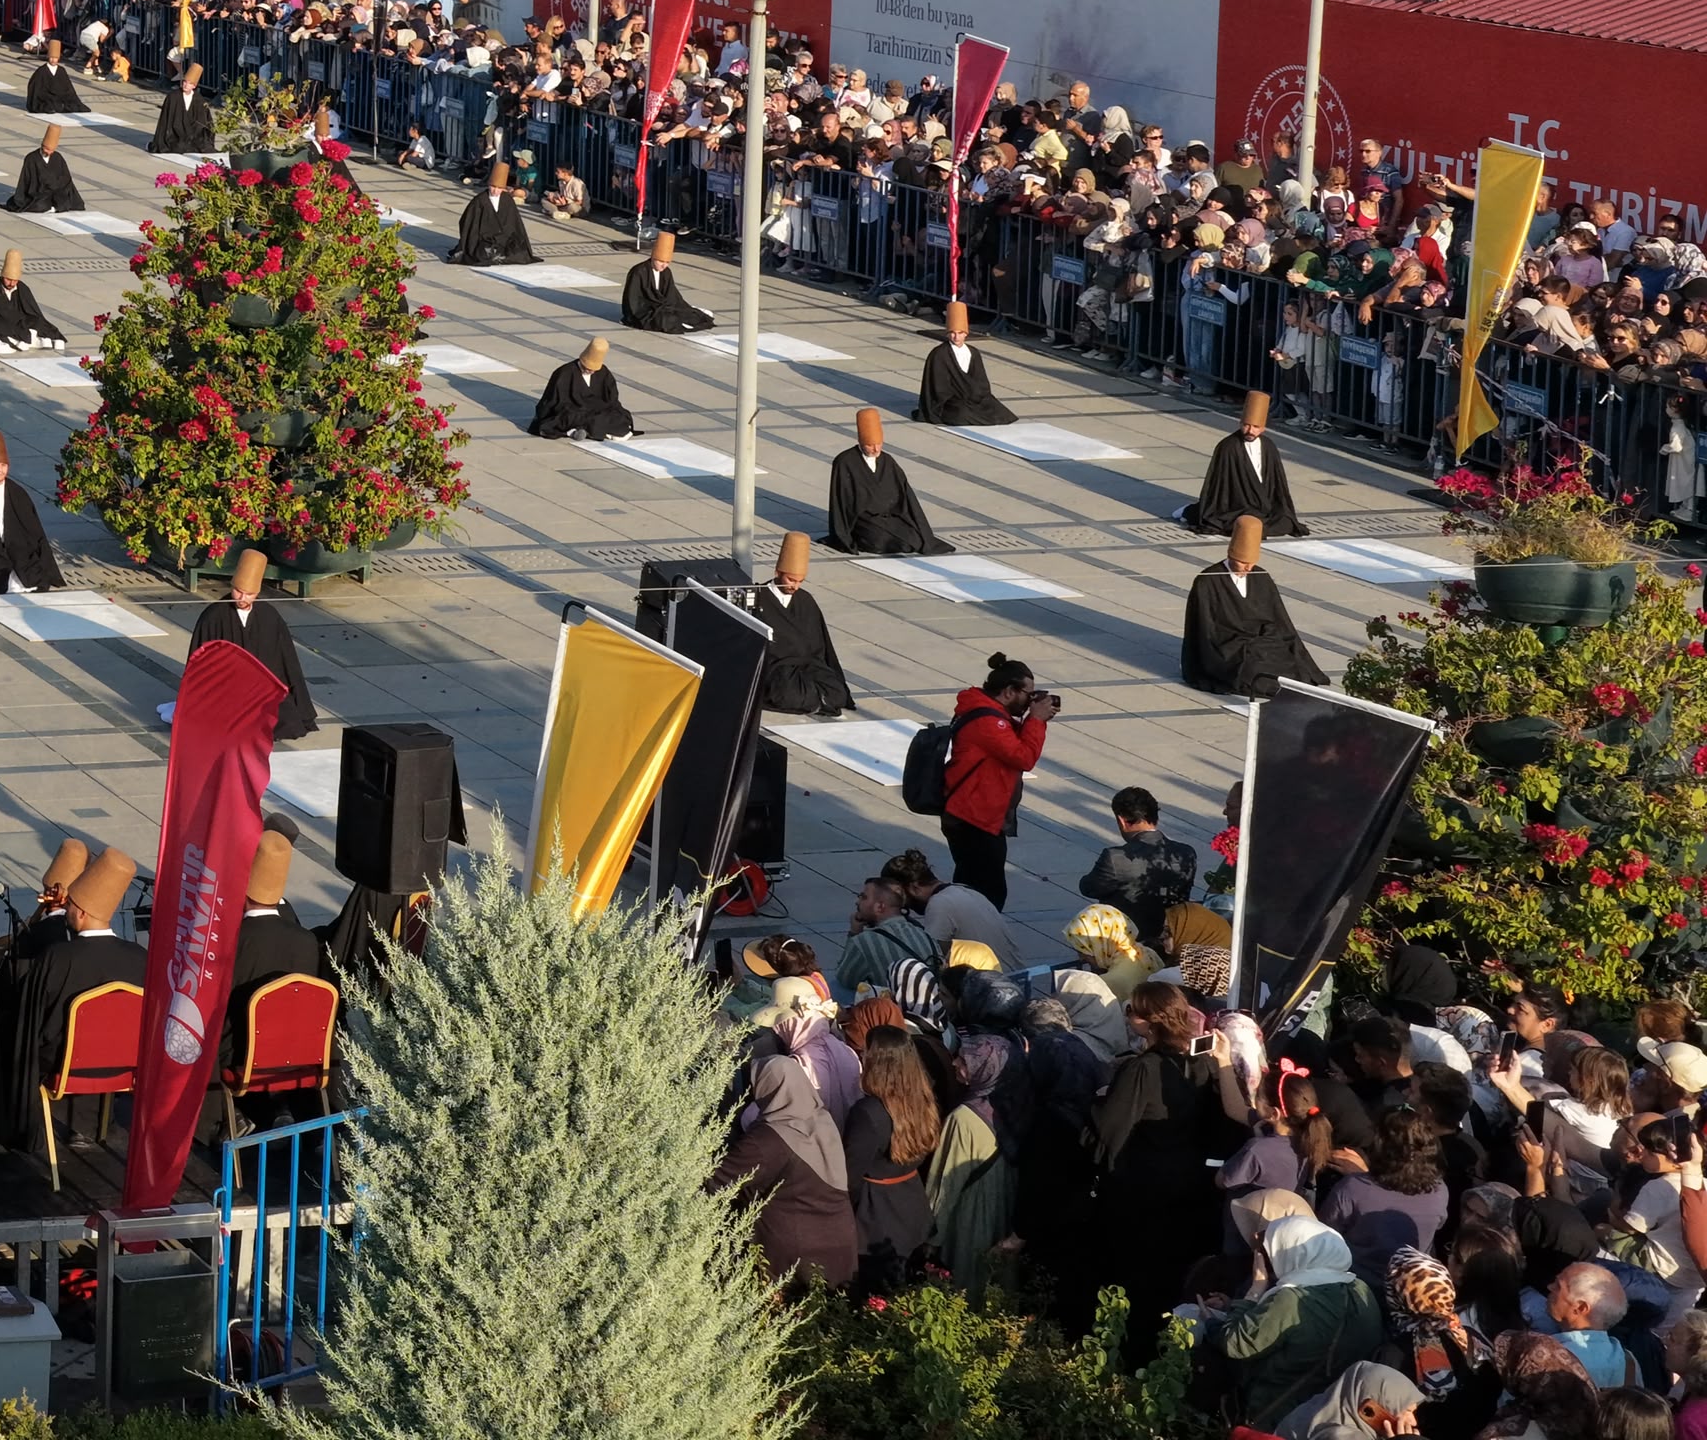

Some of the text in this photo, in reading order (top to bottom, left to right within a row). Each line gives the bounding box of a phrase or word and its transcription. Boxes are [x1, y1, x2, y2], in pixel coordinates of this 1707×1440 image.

[927, 3, 943, 24] bu
[944, 11, 975, 30] yana
[866, 32, 942, 65] Tarihimizin
[204, 896, 224, 979] KONYA
